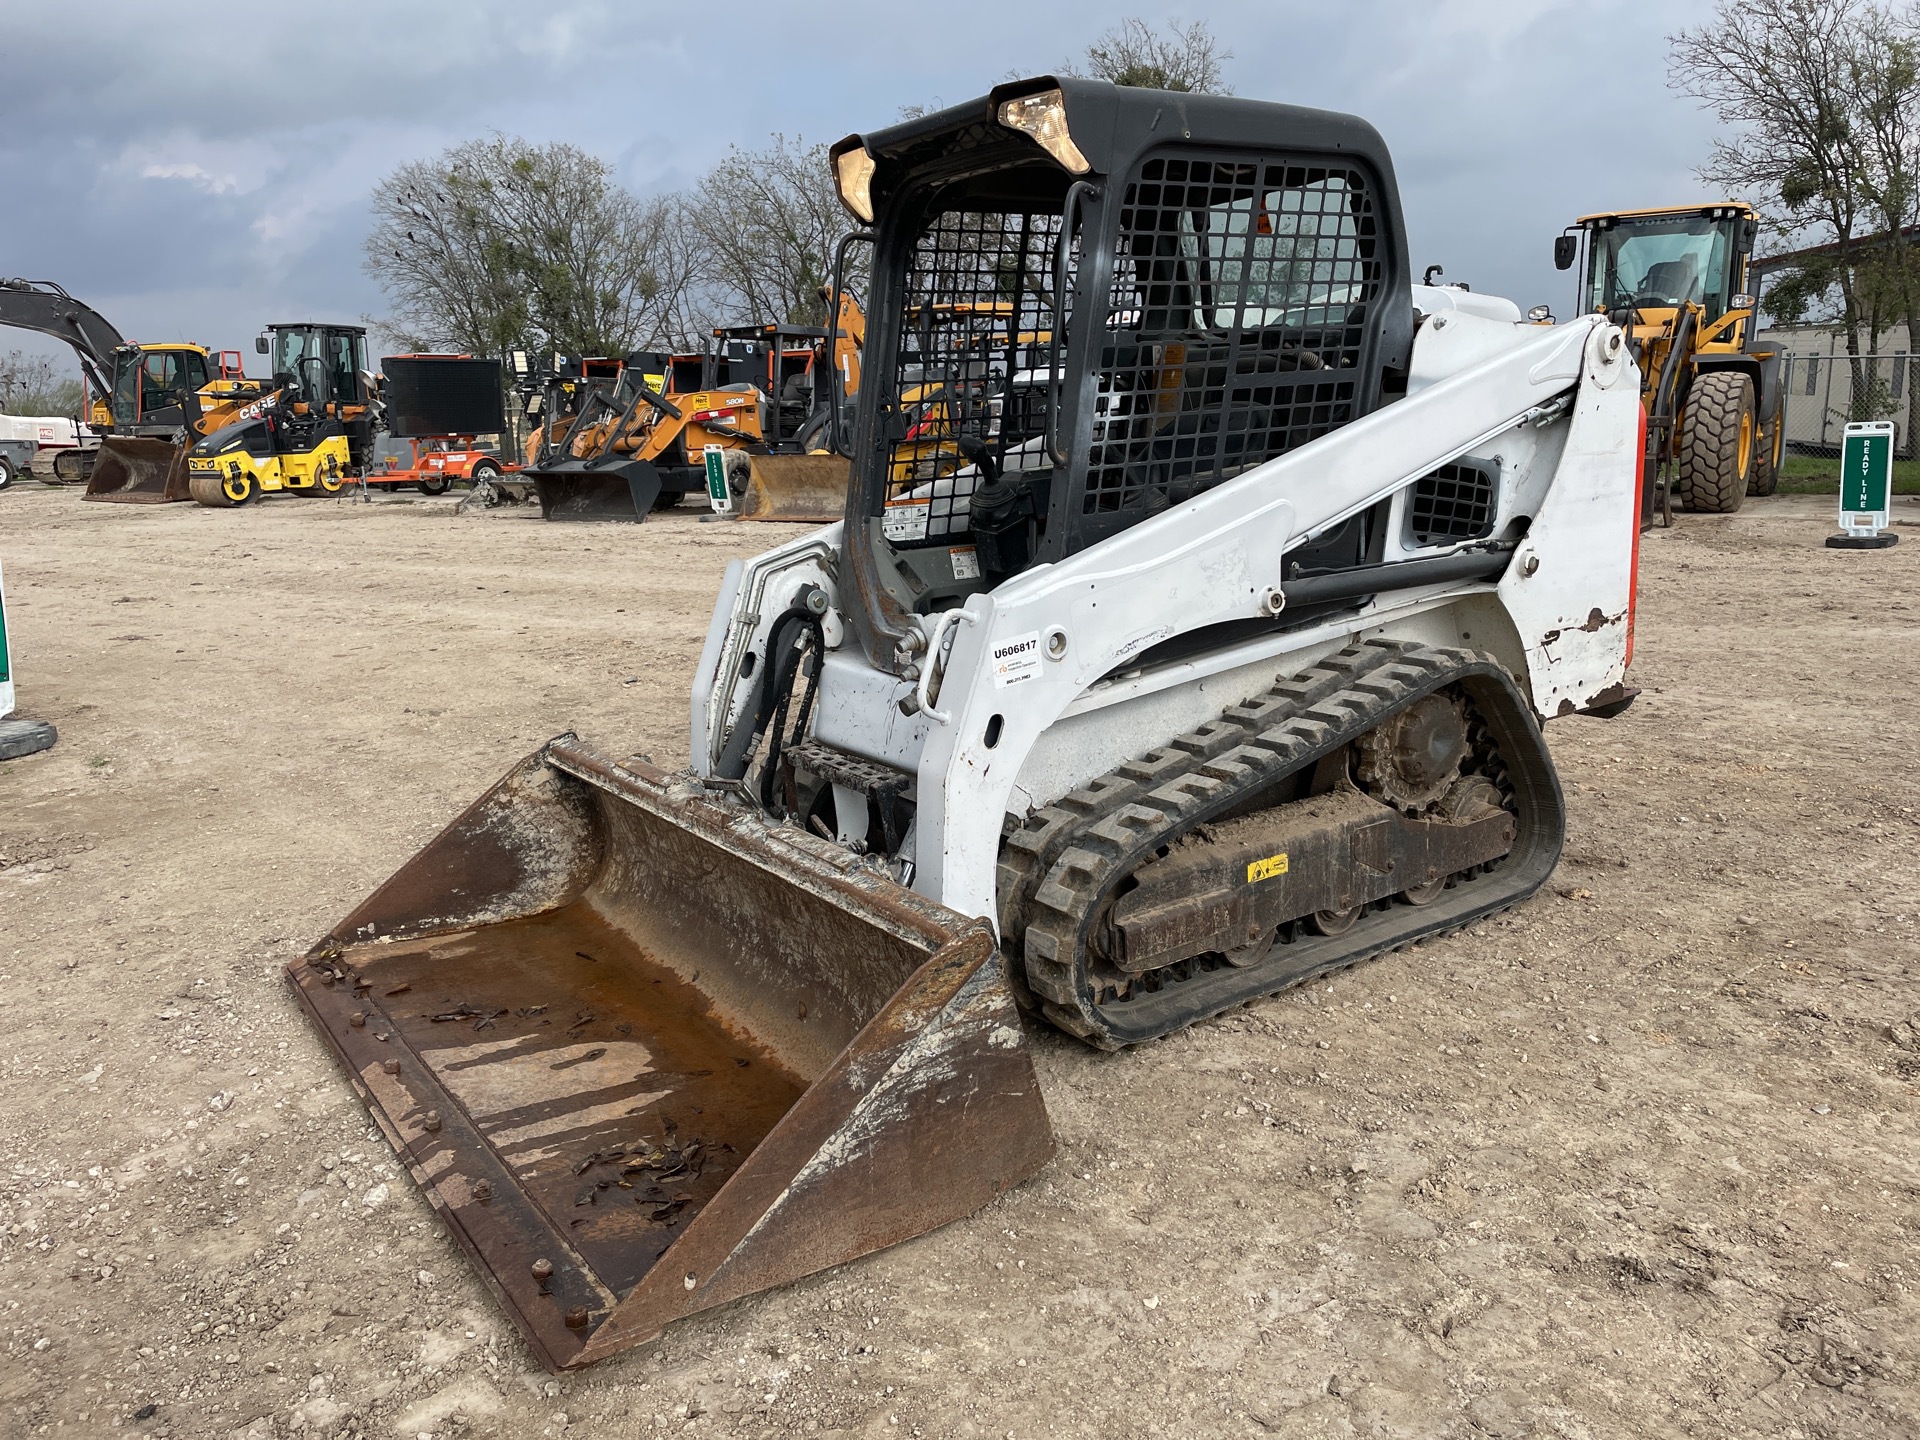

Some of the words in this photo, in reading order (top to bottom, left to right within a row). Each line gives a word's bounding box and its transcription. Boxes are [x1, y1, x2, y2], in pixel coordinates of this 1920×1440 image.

[1634, 216, 1687, 227] VOLVO
[647, 381, 661, 389] Herc
[239, 395, 276, 420] CASE
[725, 397, 745, 406] 580N
[1862, 439, 1870, 476] READY
[1860, 479, 1868, 508] LINE
[994, 639, 1037, 659] U606817
